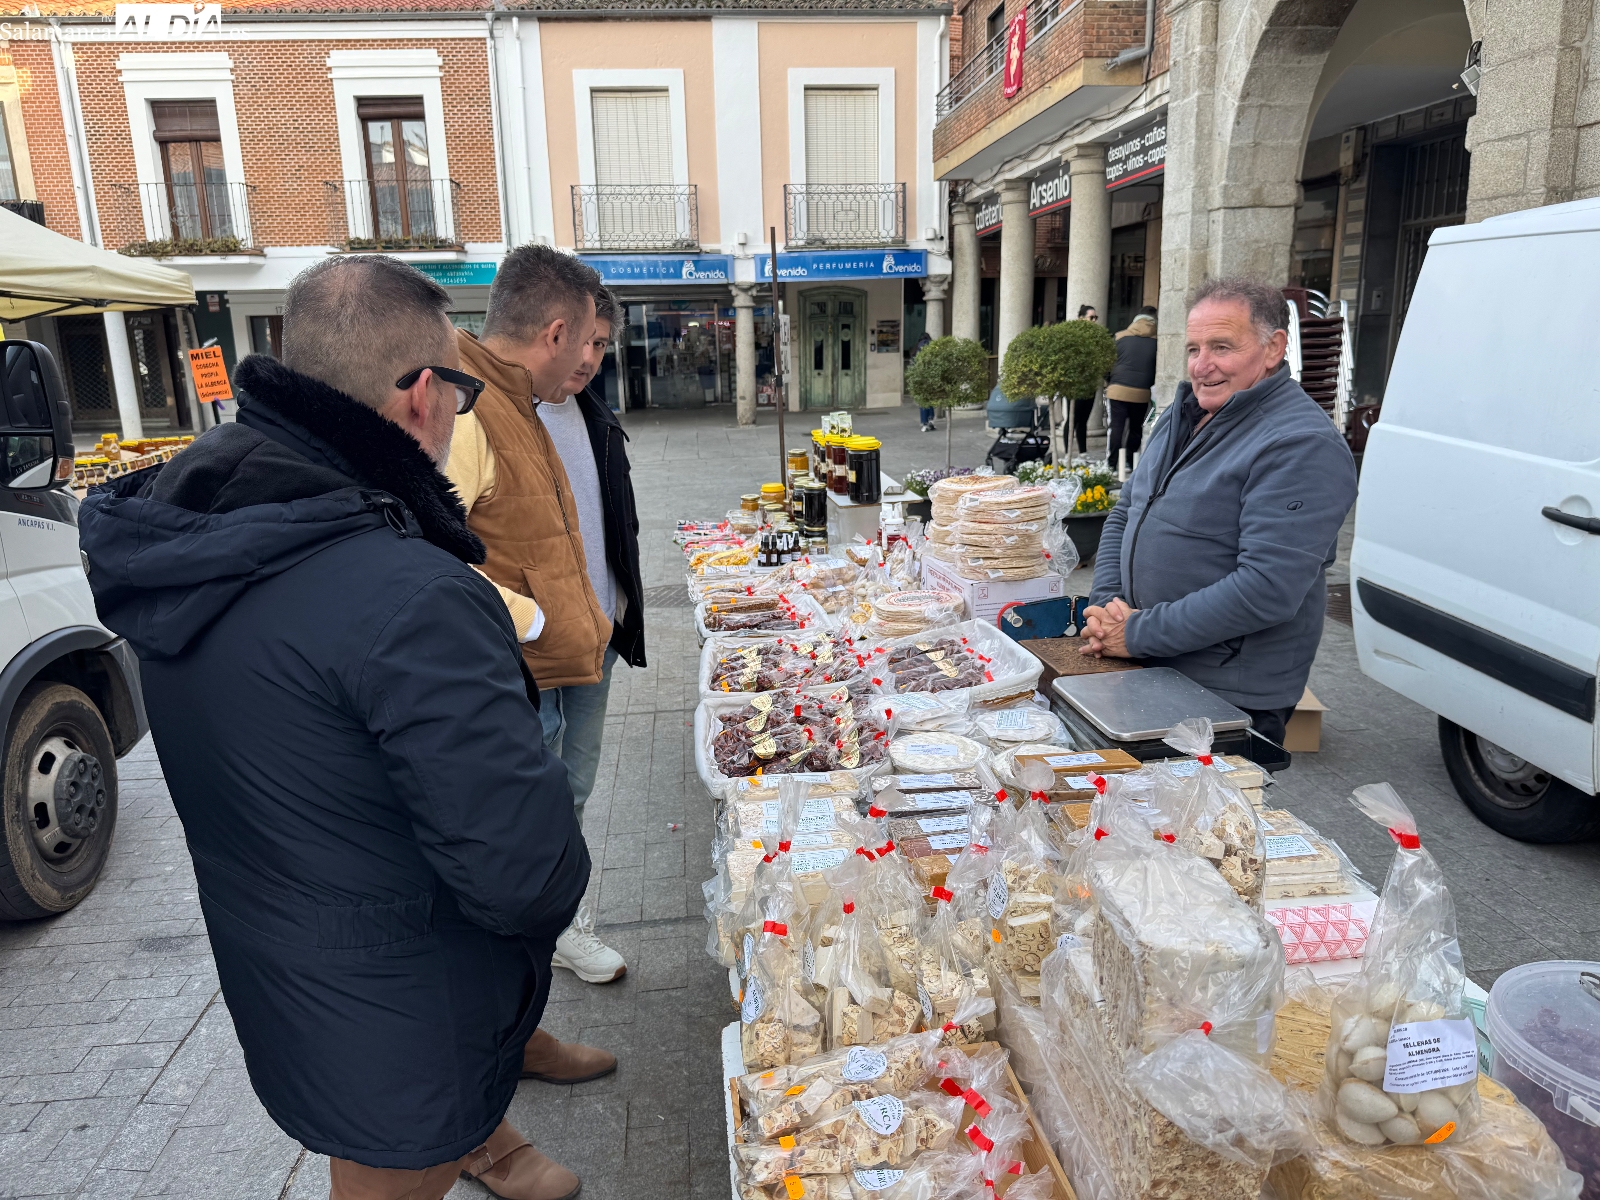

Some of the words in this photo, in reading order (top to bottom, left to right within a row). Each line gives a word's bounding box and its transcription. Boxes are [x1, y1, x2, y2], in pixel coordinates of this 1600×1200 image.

[1107, 137, 1141, 162] desayunos
[1144, 126, 1166, 147] cañas
[1105, 162, 1124, 181] tapas
[1126, 154, 1144, 171] vinos
[1029, 169, 1071, 210] Arsenio
[812, 261, 875, 270] PERFUMERÍA
[190, 350, 221, 361] MIEL
[195, 361, 220, 370] COSECHA
[200, 371, 219, 379] PROPIA
[204, 379, 227, 388] ALBERCA
[17, 517, 45, 530] ANCAPAS
[1408, 1046, 1441, 1057] ALMENDRA
